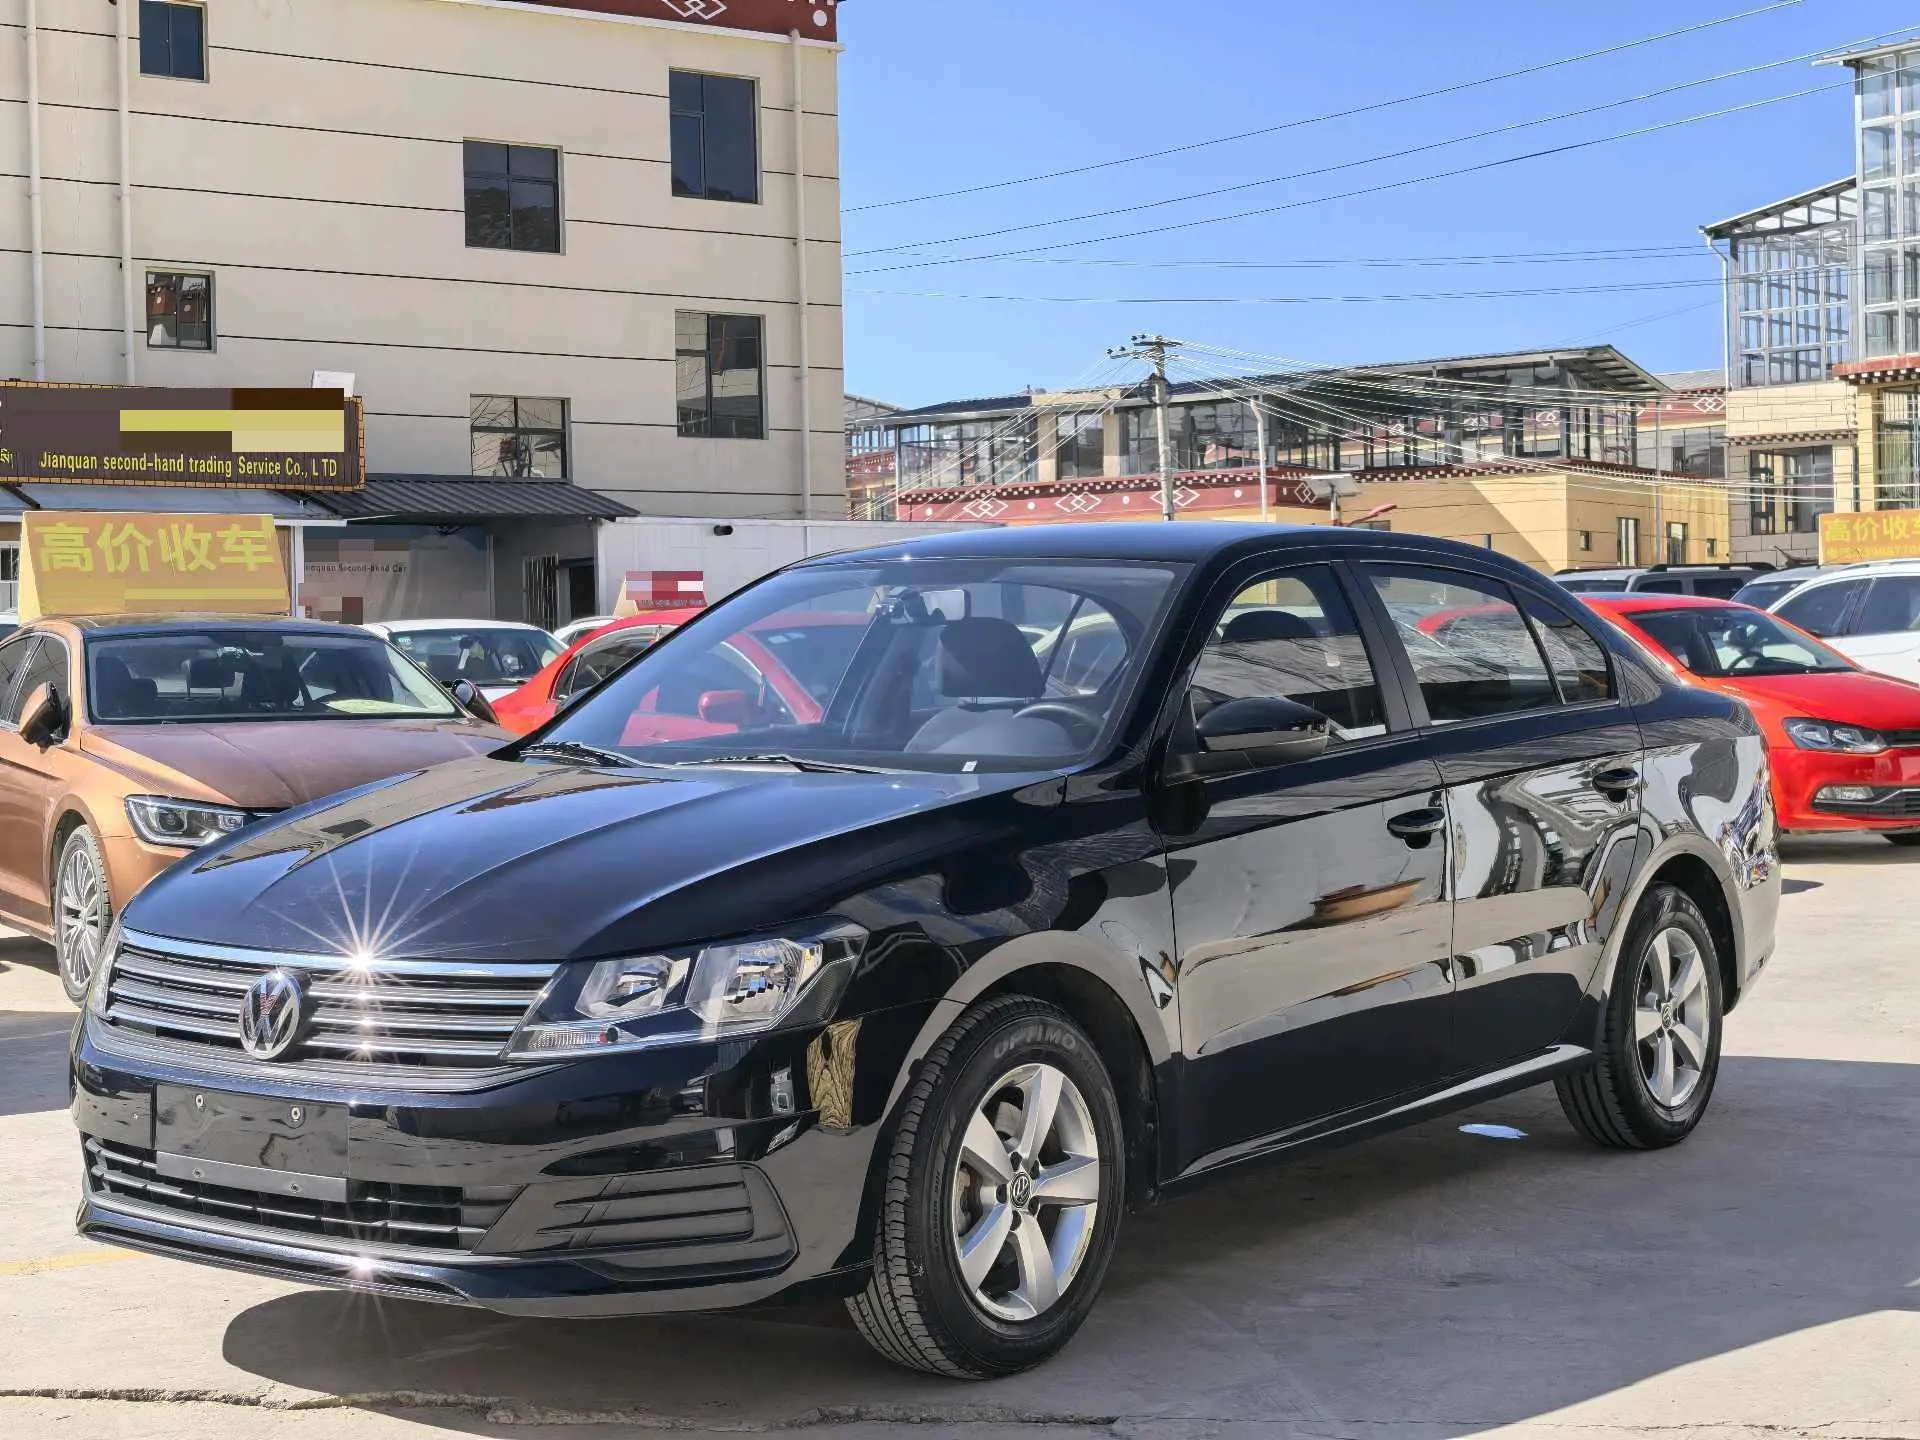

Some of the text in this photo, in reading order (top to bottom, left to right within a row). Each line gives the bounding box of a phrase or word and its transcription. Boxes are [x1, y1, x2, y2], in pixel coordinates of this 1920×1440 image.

[39, 451, 98, 473] Jianquan
[103, 452, 184, 473] second-hand
[188, 455, 232, 478] trading
[238, 455, 281, 475] Service
[285, 457, 308, 479] Co.,
[34, 522, 275, 572] 高价收车
